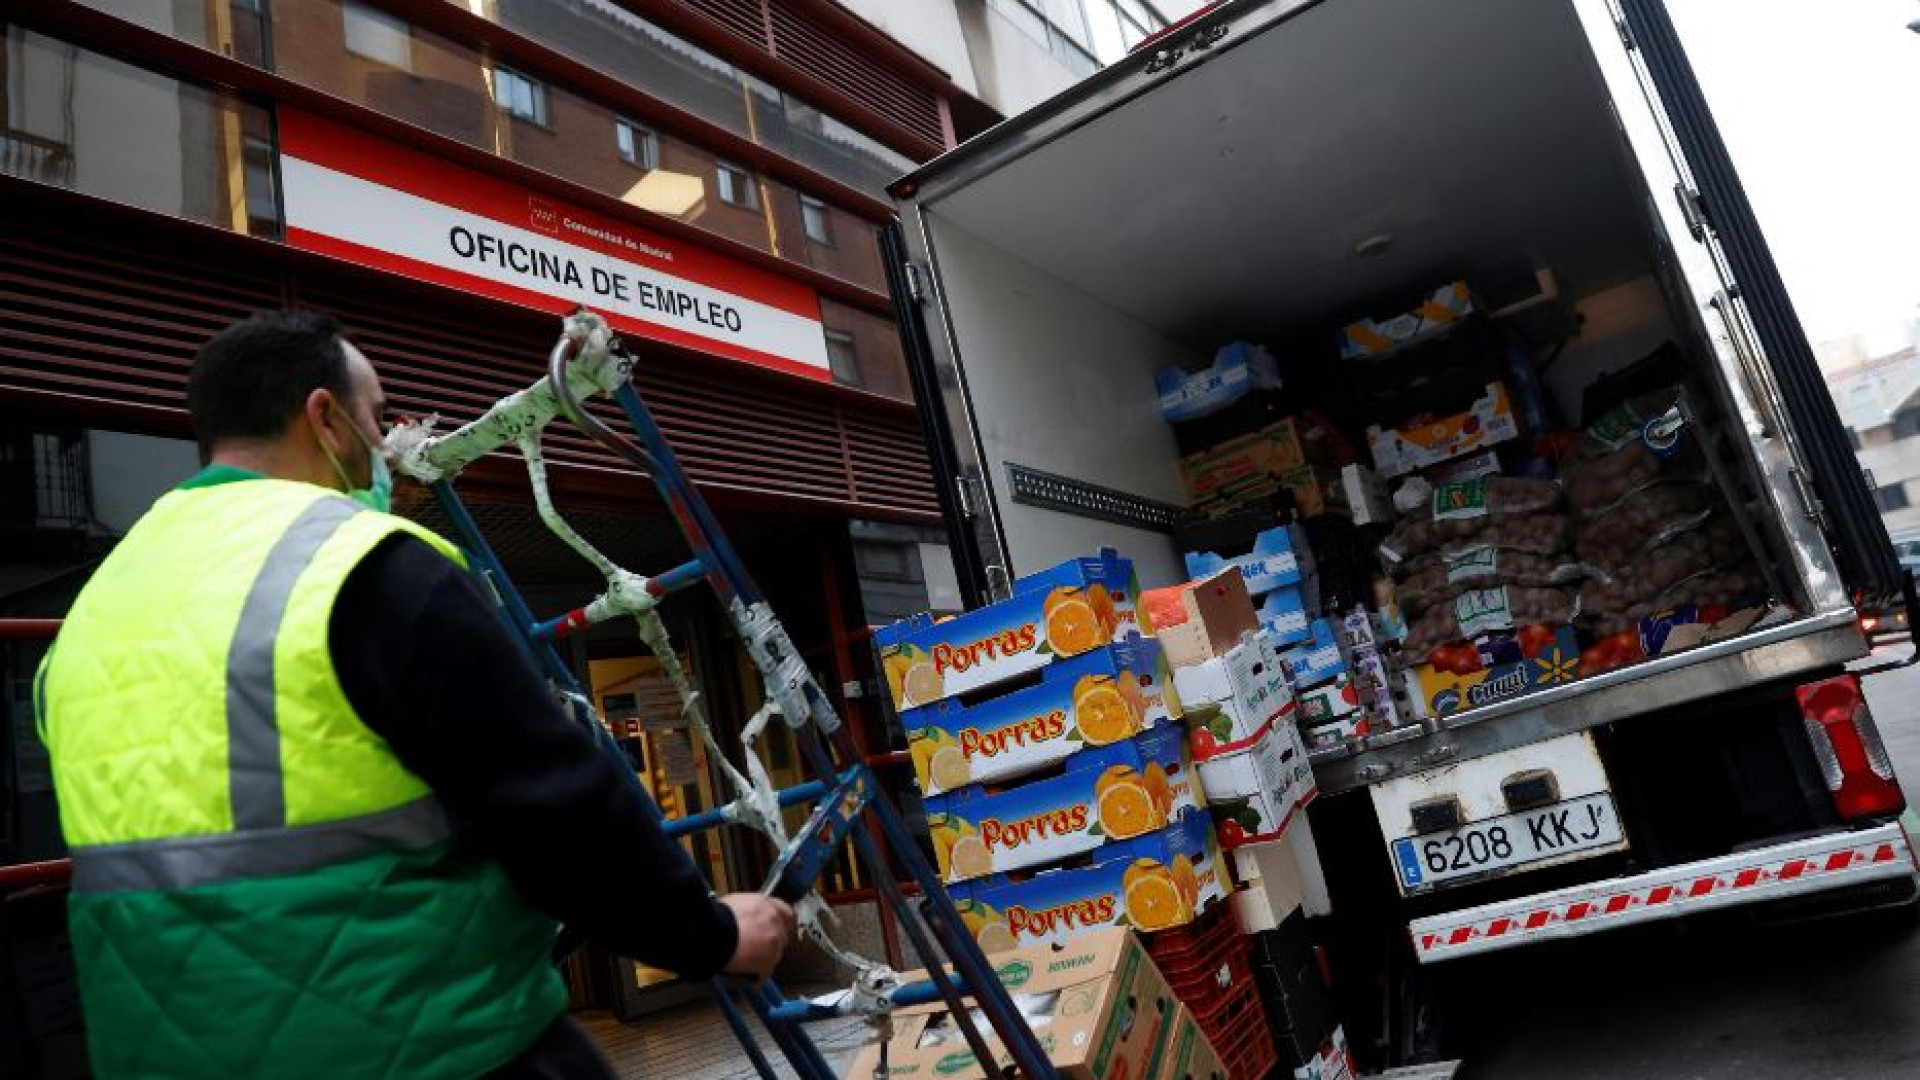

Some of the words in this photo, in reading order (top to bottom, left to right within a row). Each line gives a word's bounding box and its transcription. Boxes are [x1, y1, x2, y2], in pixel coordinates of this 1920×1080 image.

[449, 225, 583, 289] OFICINA
[591, 266, 631, 302] DE
[637, 280, 742, 332] EMPLEO
[931, 622, 1038, 676] Porras
[958, 709, 1067, 760] Porras
[980, 803, 1088, 854] Porras
[1423, 826, 1513, 873] 6208
[1526, 803, 1600, 851] KKJ
[1006, 894, 1116, 938] Porras
